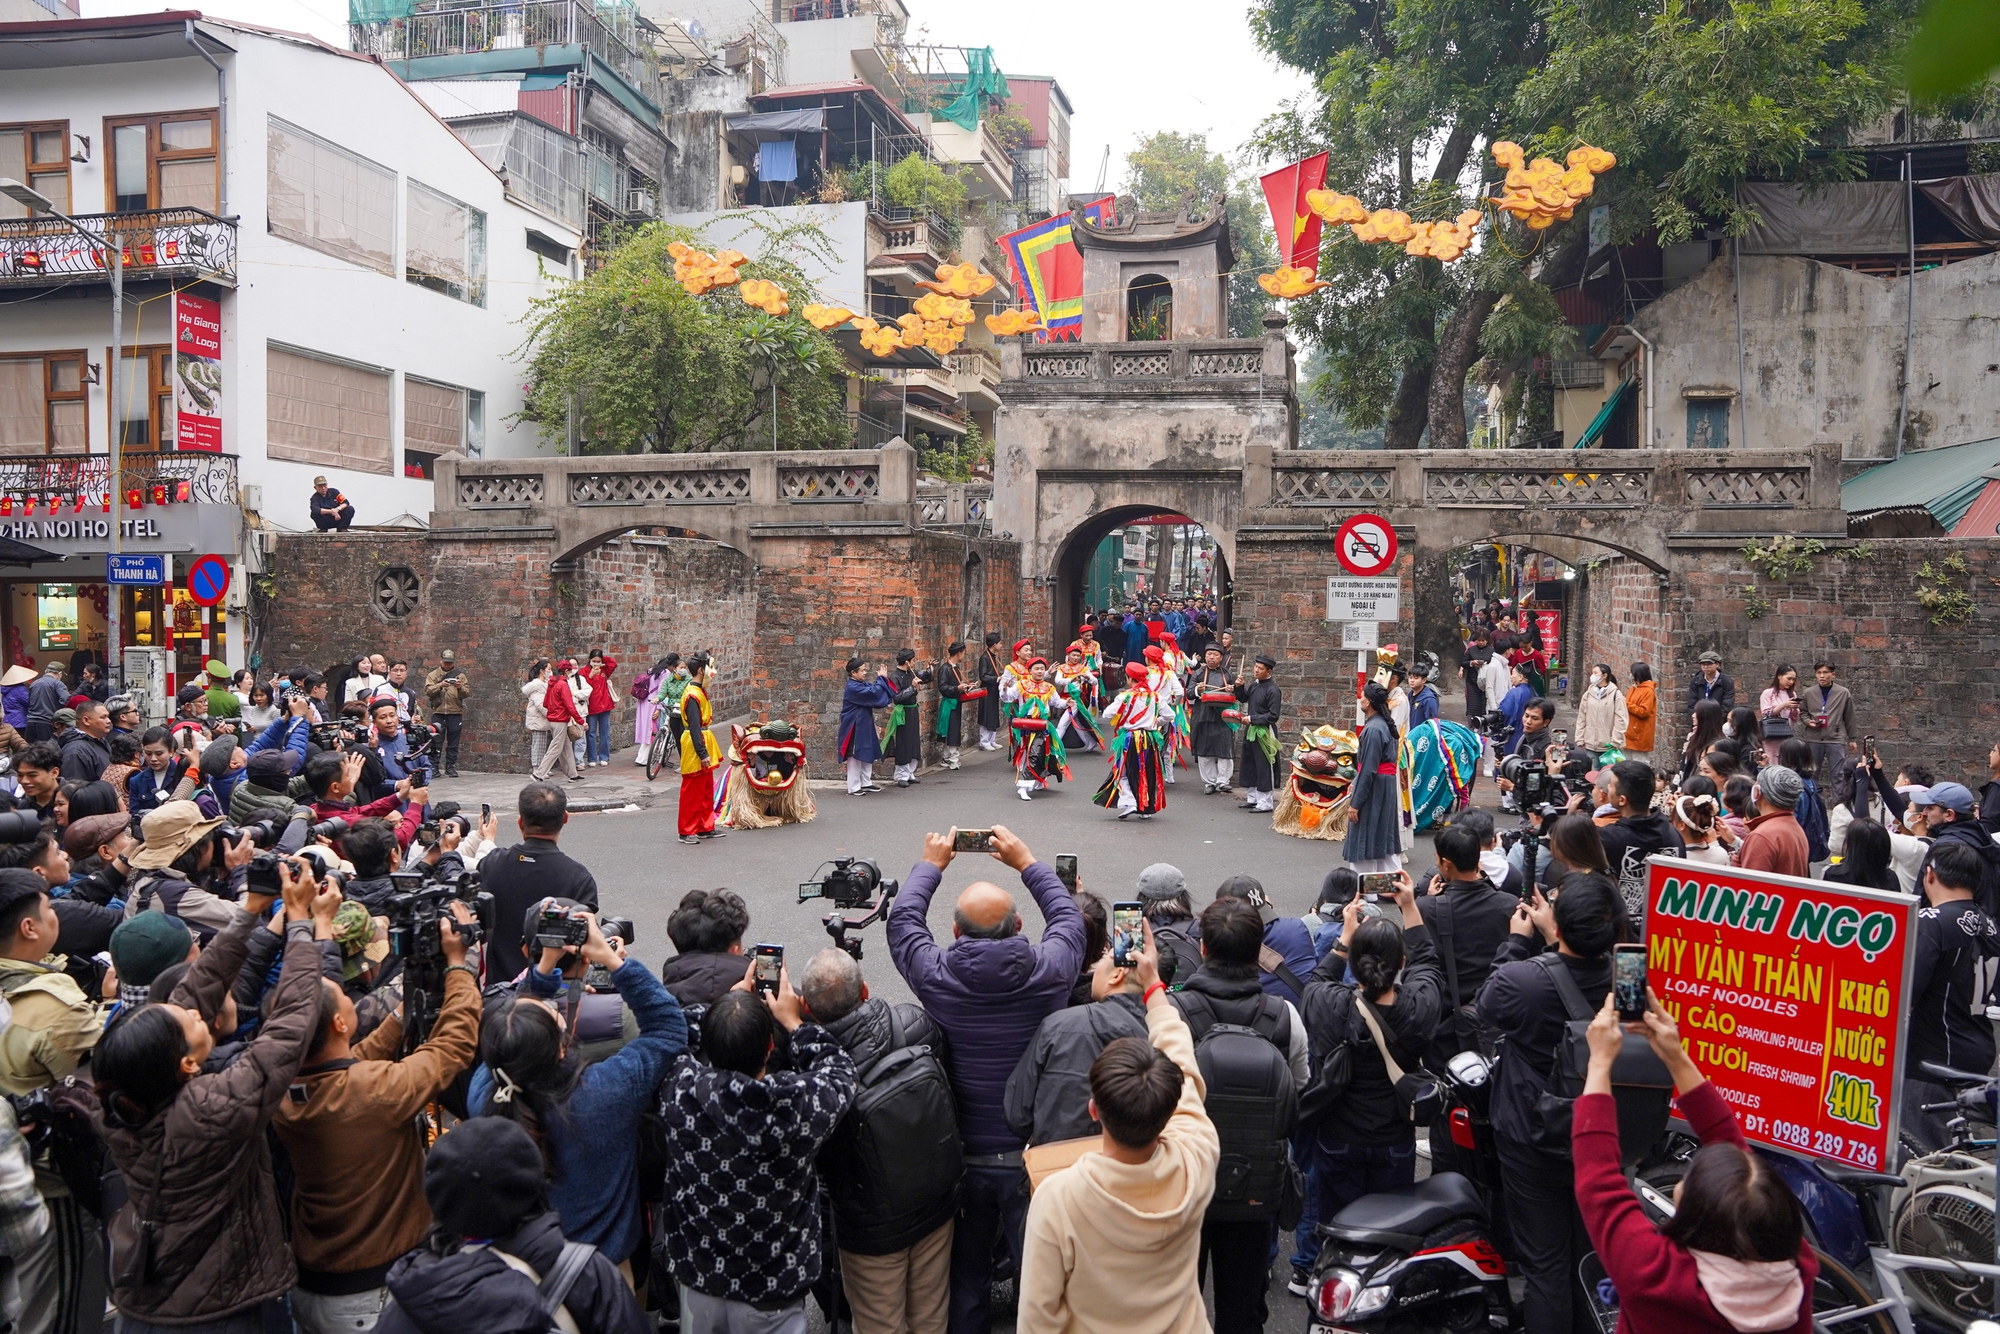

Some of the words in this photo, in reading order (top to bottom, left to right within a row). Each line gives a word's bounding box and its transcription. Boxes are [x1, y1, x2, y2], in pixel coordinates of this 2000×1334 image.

[179, 313, 192, 324] Ha
[194, 316, 219, 333] Giang
[196, 336, 218, 350] Loop
[181, 431, 195, 439] NOW
[12, 521, 39, 538] HA
[44, 520, 76, 538] NOI
[81, 519, 158, 538] HOTEL
[114, 569, 144, 580] THANH
[146, 567, 158, 580] HÀ
[126, 557, 144, 566] PHỐ
[1351, 602, 1368, 610] NGOẠI
[1370, 600, 1376, 610] LỆ
[1657, 878, 1784, 934] MINH
[1788, 900, 1896, 962] NGỌ
[1649, 928, 1687, 975] MỲ
[1694, 930, 1744, 988] VẰN
[1752, 945, 1823, 1004] THẮN
[1664, 978, 1710, 998] LOAF
[1712, 988, 1798, 1018] NOODLES
[1838, 979, 1890, 1018] KHÔ
[1687, 1004, 1736, 1034] CẢO
[1736, 1024, 1786, 1048] SPARKLING
[1787, 1036, 1824, 1056] PULLER
[1833, 1025, 1886, 1067] NƯỚC
[1696, 1040, 1748, 1073] TƯƠI
[1748, 1061, 1779, 1081] FRESH
[1779, 1068, 1816, 1089] SHRIMP
[1827, 1072, 1880, 1128] 40k
[1745, 1114, 1769, 1135] ĐT:
[1772, 1119, 1809, 1146] 0988
[1814, 1130, 1844, 1156] 289
[1848, 1140, 1878, 1166] 736
